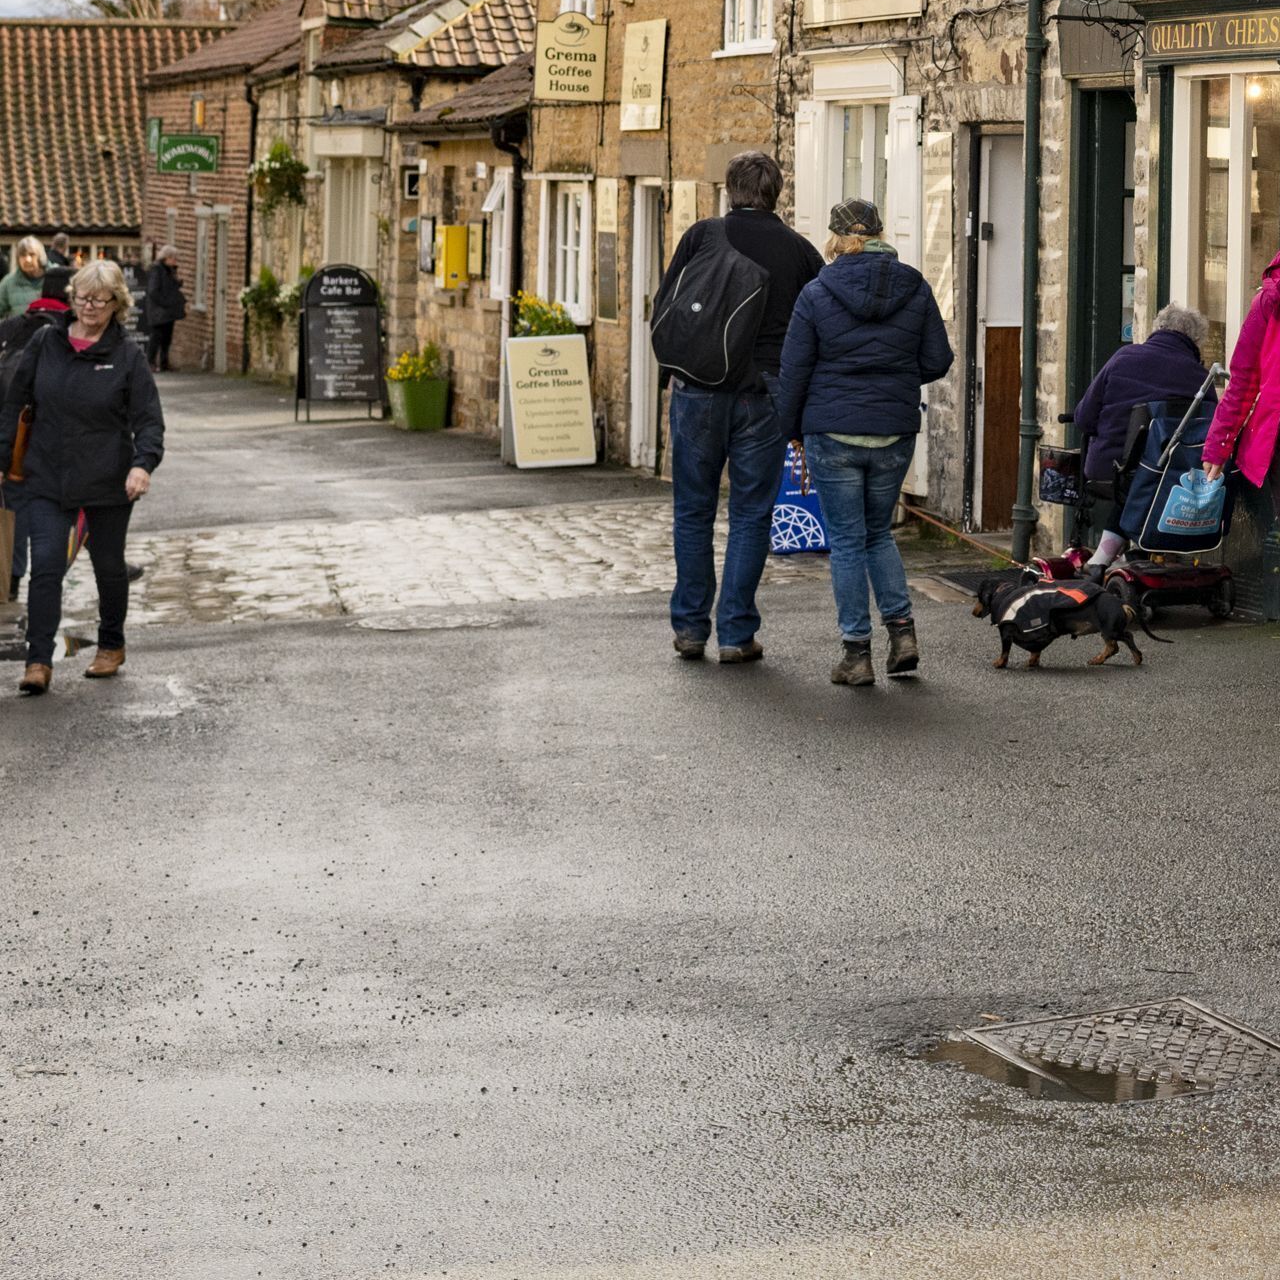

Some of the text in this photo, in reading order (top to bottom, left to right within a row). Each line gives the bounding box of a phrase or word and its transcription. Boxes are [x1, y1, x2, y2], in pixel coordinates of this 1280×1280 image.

[1152, 20, 1217, 53] QUALITY
[548, 65, 592, 78] Coffee
[549, 80, 590, 93] House
[323, 275, 359, 285] Barkers
[345, 287, 362, 295] Bar
[516, 378, 584, 390] Coffee House
